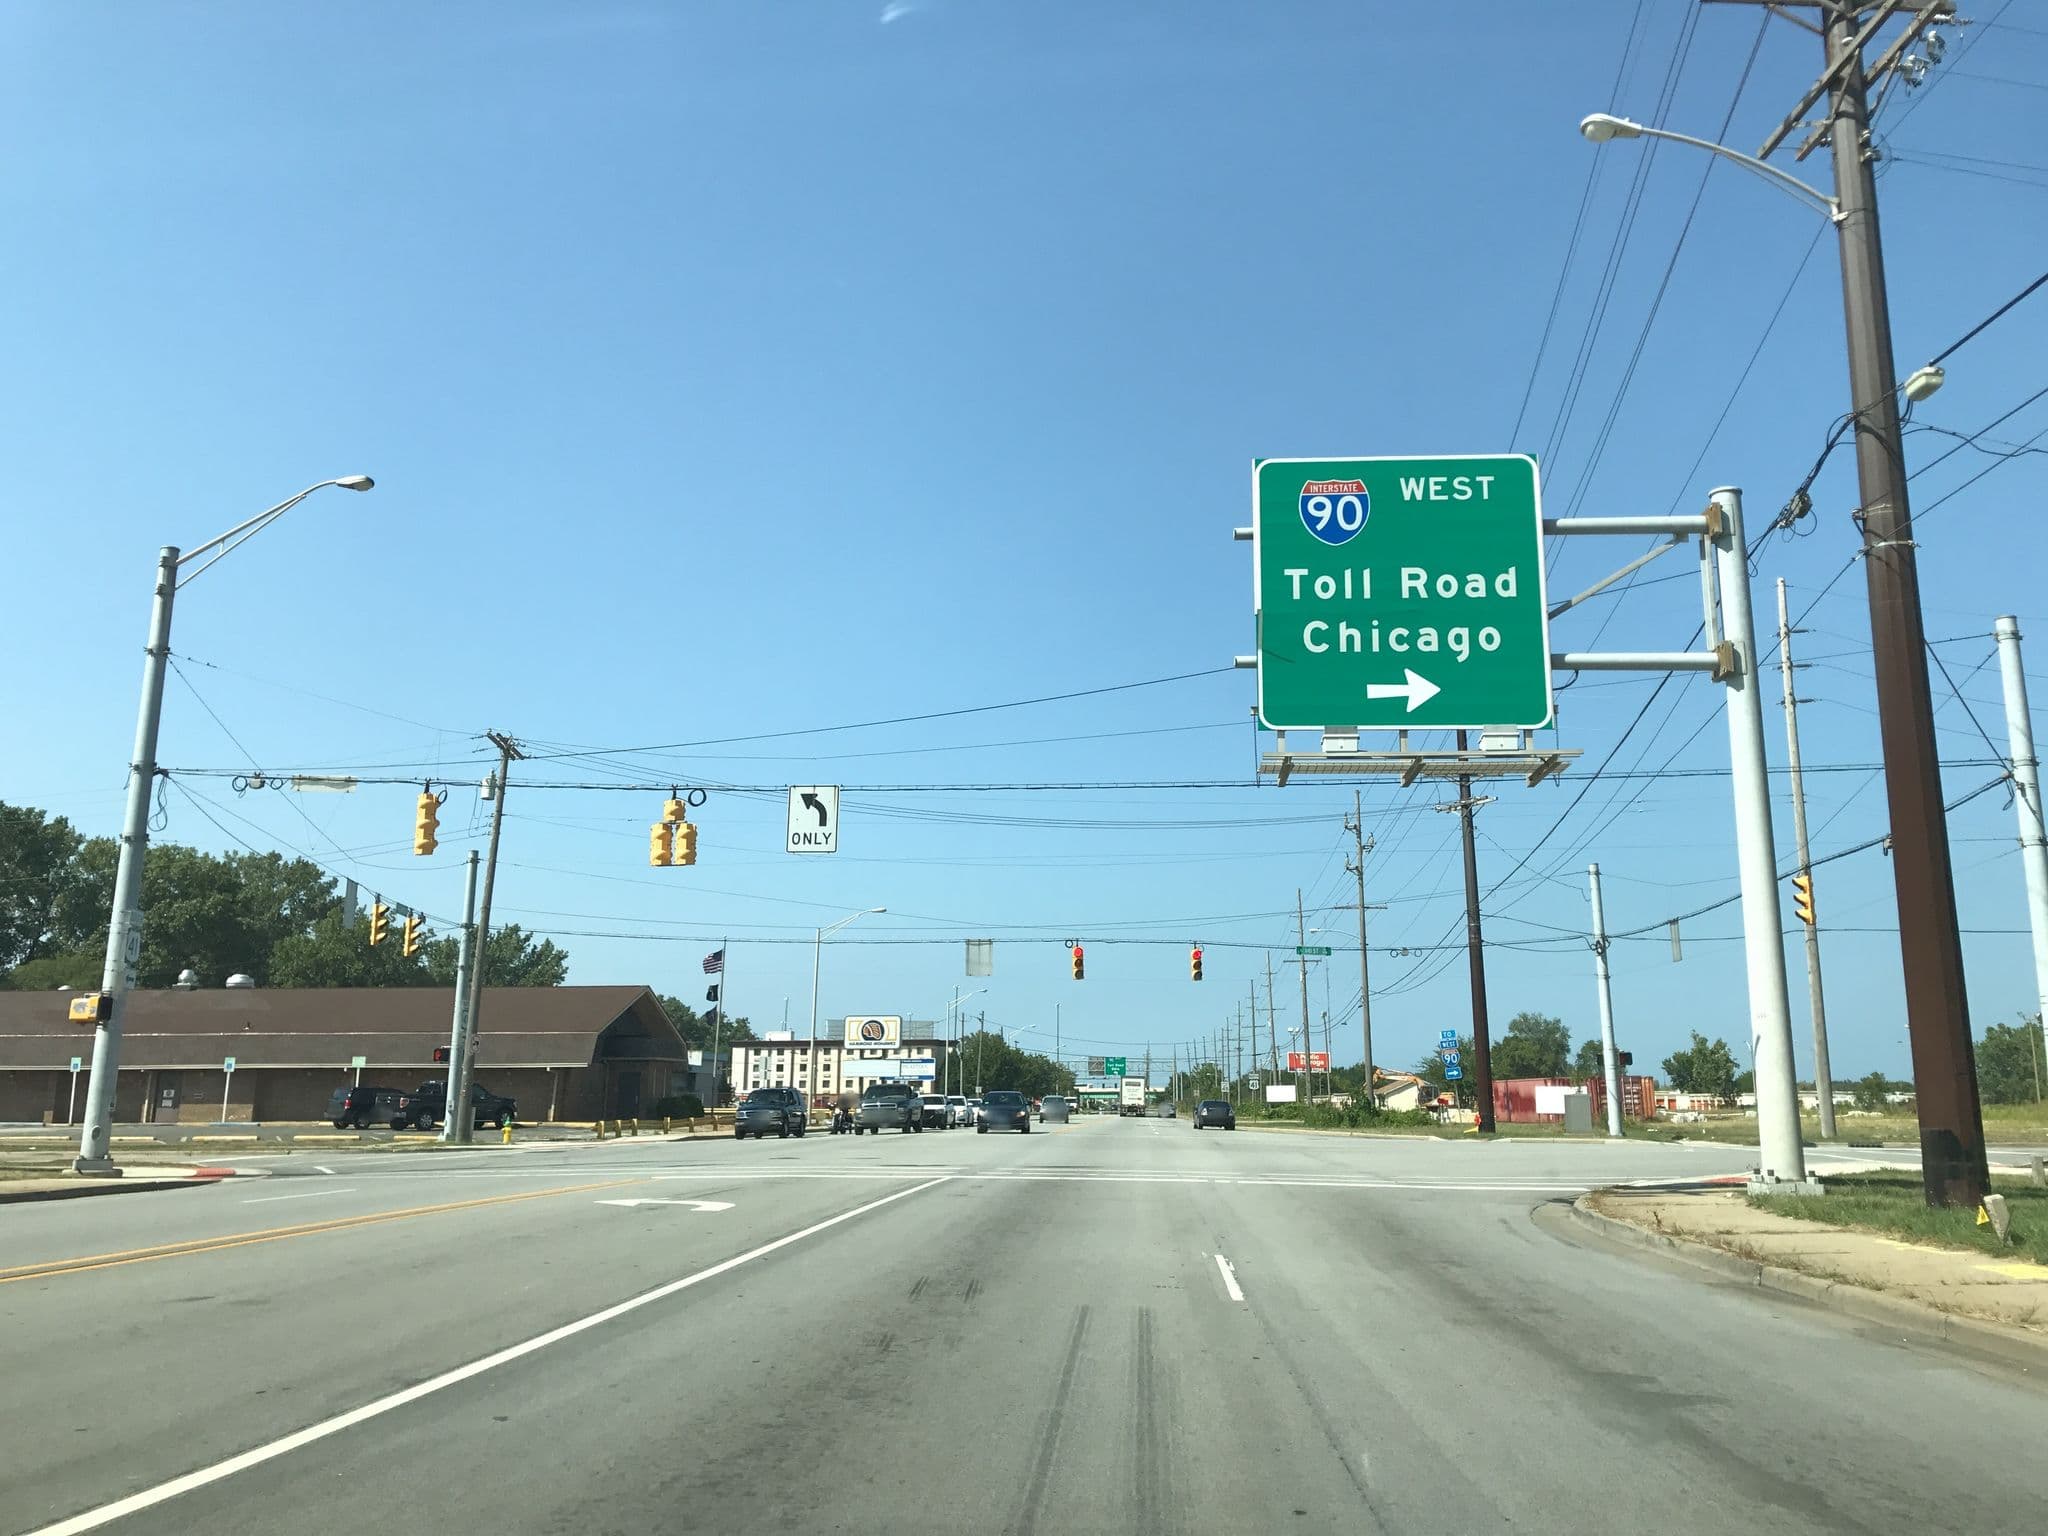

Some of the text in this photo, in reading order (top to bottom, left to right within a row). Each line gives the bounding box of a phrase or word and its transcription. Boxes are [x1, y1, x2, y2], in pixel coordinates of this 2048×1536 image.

[1310, 484, 1359, 493] INTERSTATE
[1400, 476, 1494, 501] WEST
[1307, 495, 1363, 531] 90
[1284, 566, 1517, 600] Toll Road
[1303, 620, 1501, 662] Chicago
[792, 832, 832, 845] ONLY
[128, 937, 139, 955] 41
[1444, 1054, 1458, 1064] 90
